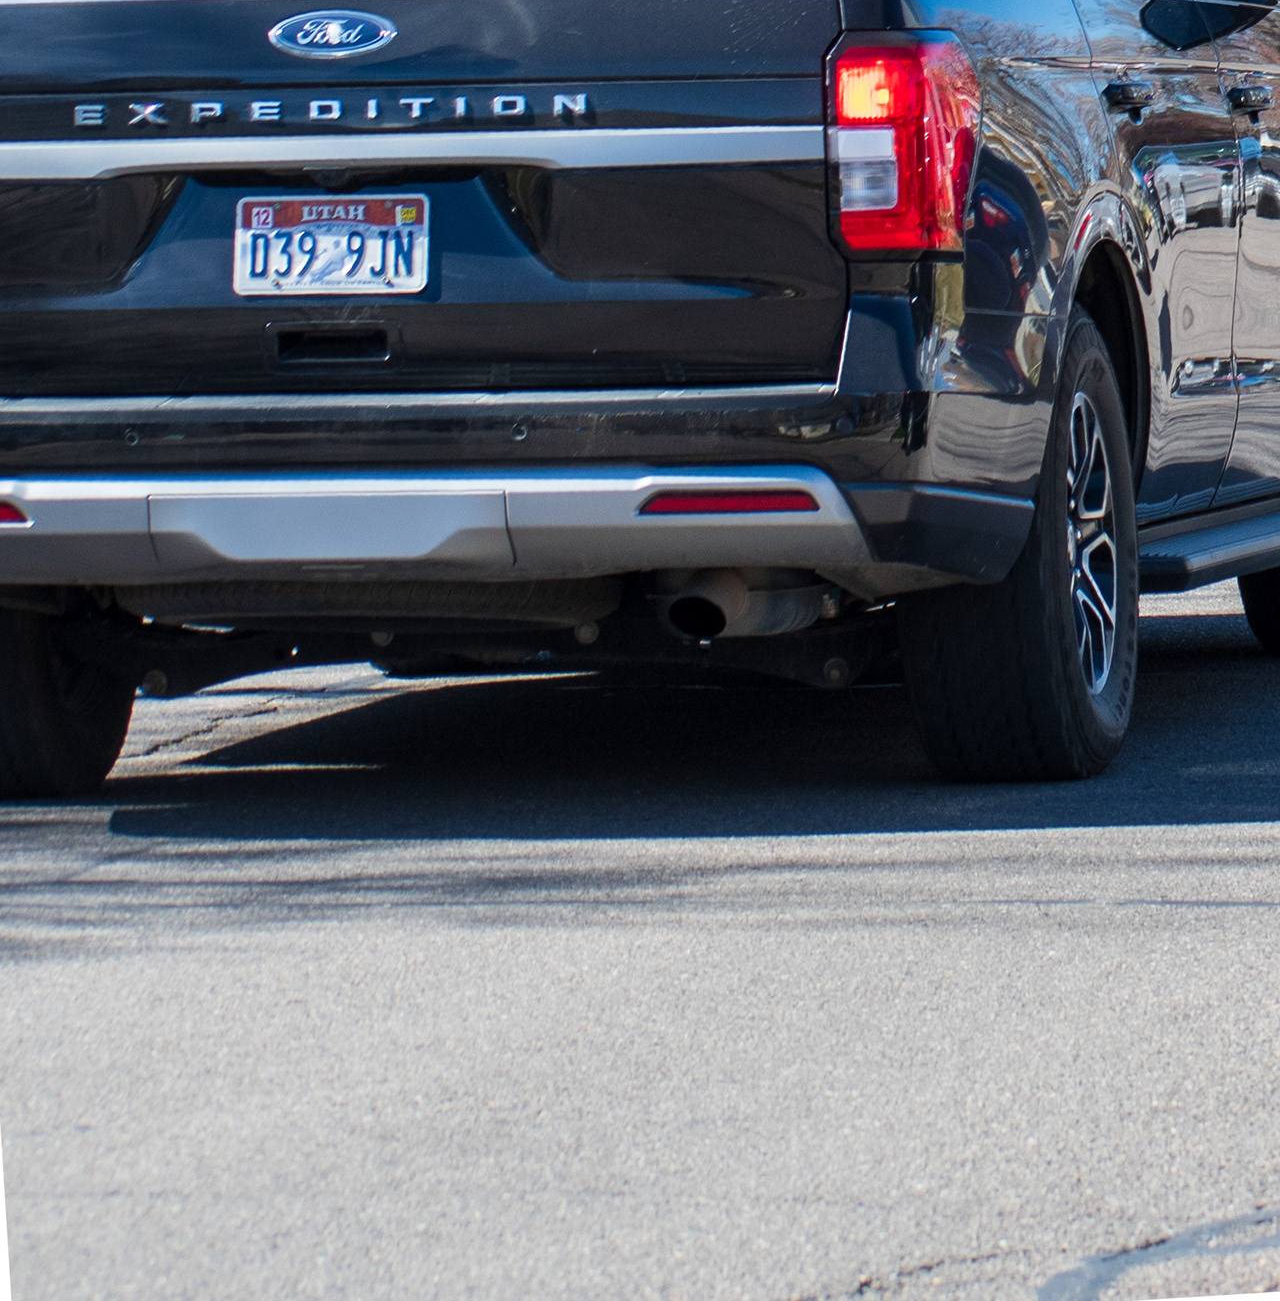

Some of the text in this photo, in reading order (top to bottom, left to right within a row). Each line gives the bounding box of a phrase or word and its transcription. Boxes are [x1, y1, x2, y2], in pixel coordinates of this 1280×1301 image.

[296, 19, 364, 45] Fod
[74, 93, 588, 127] EXPEDITION
[253, 210, 271, 227] 12
[301, 204, 367, 222] UTAH
[249, 229, 414, 278] D39 9JN
